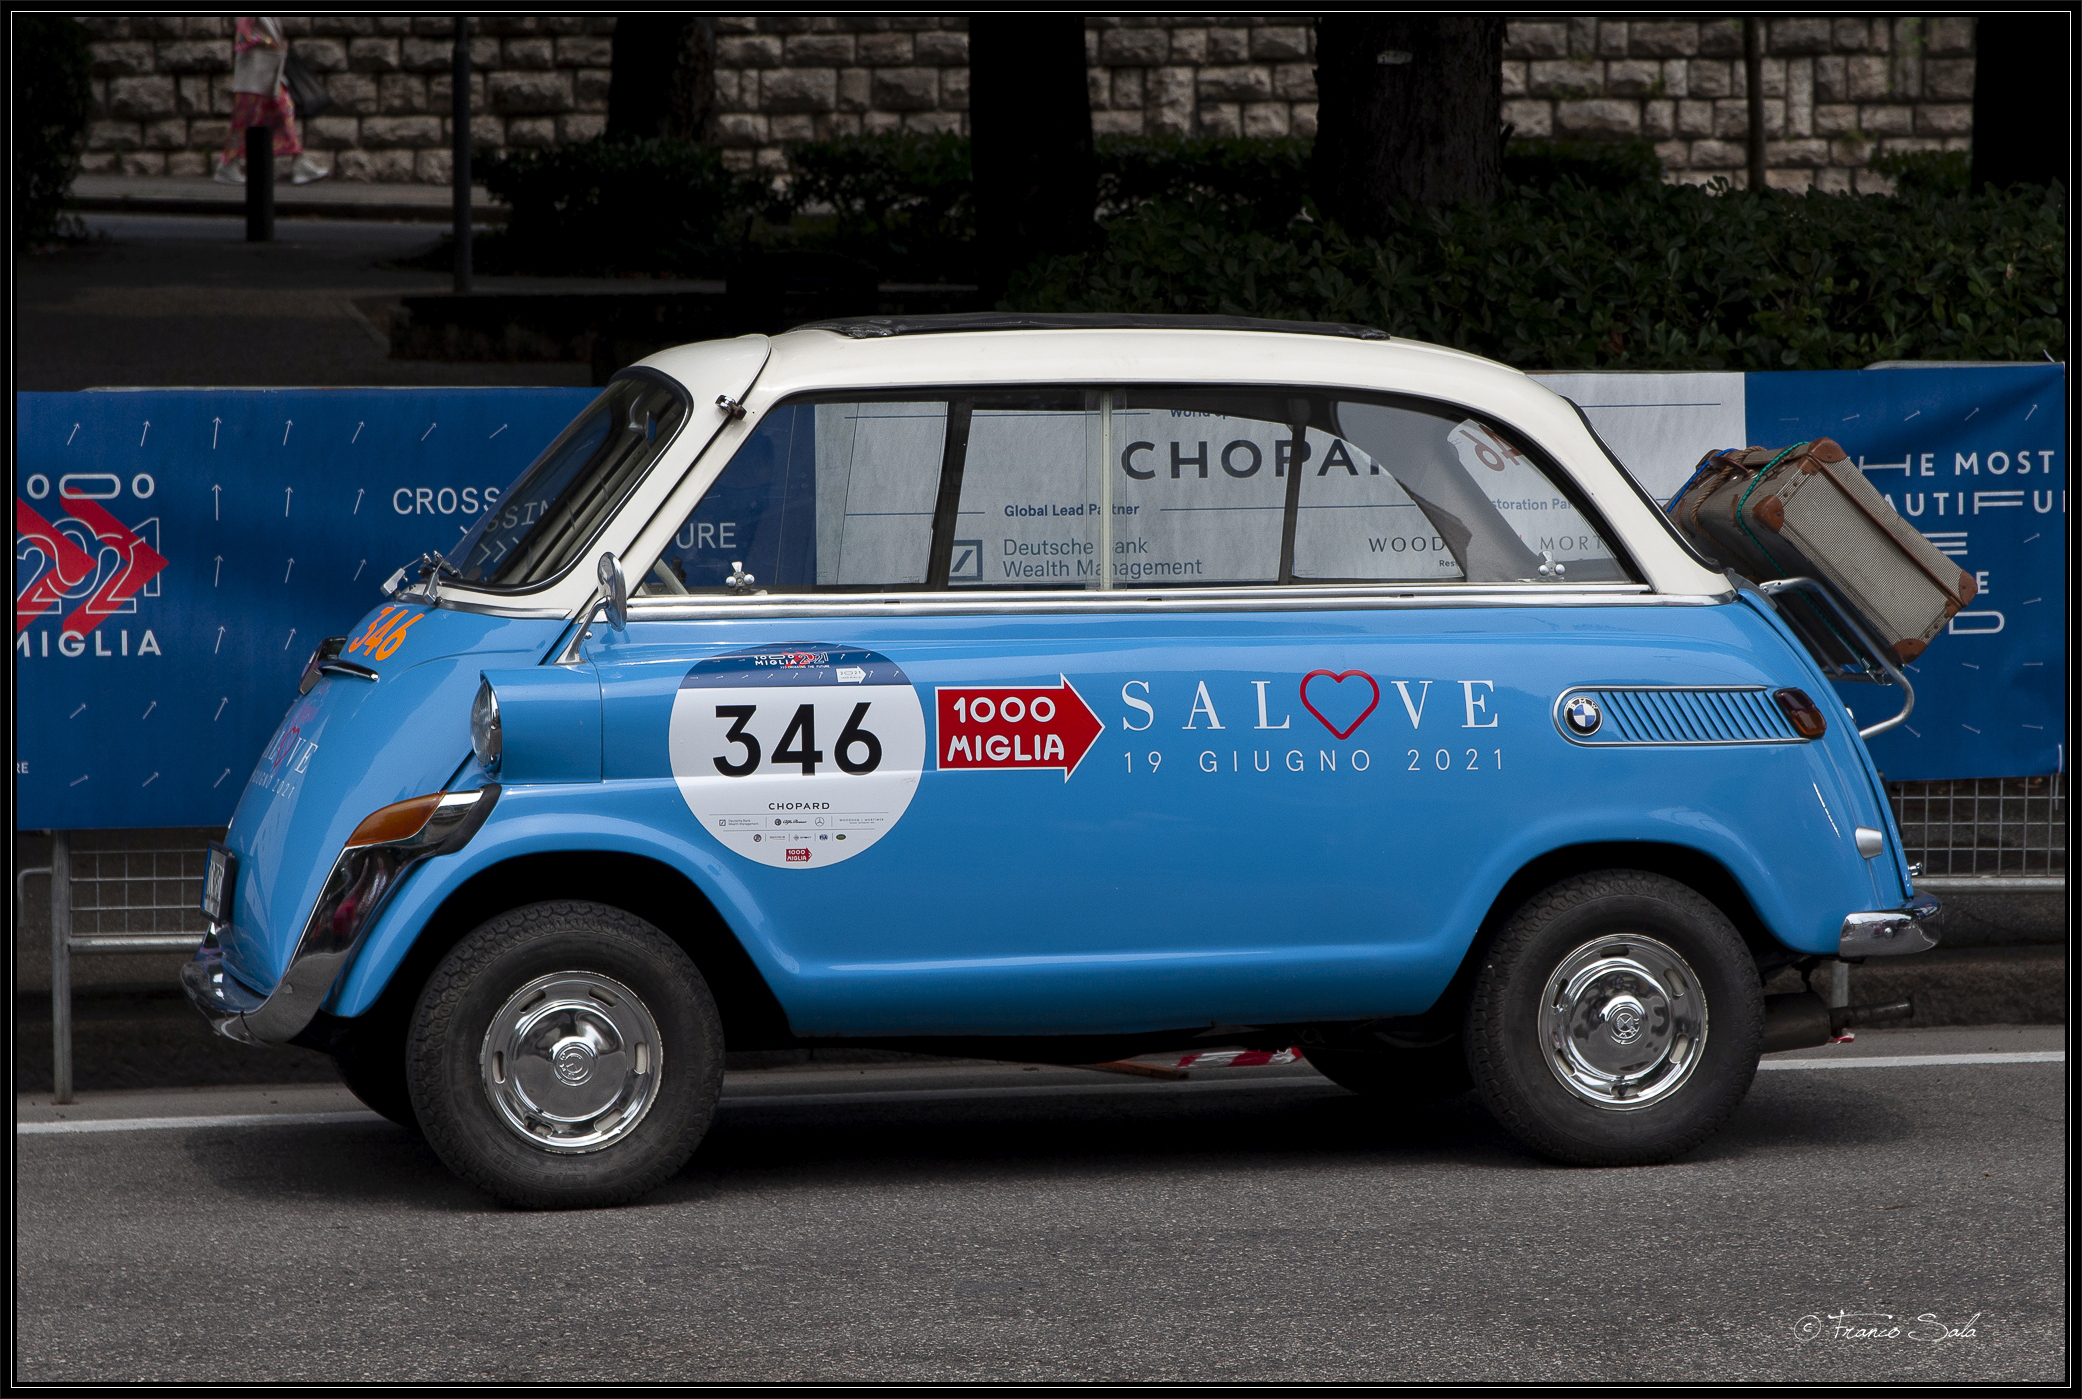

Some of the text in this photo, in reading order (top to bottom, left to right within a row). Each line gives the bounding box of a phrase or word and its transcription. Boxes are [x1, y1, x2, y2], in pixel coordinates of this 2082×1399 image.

[1847, 450, 2055, 477] HE MOST
[1004, 503, 1140, 517] Global Lead Ptner
[1884, 489, 2065, 517] UTIFU
[1003, 537, 1148, 556] Deutsche ank
[1003, 559, 1071, 578] Wealth
[348, 606, 425, 661] 346
[953, 696, 1056, 724] 1000
[713, 702, 882, 778] 346
[947, 733, 1065, 762] MIGLIA
[1124, 748, 1501, 773] 19 GIUGNO 2021
[768, 802, 830, 811] CHOPARD
